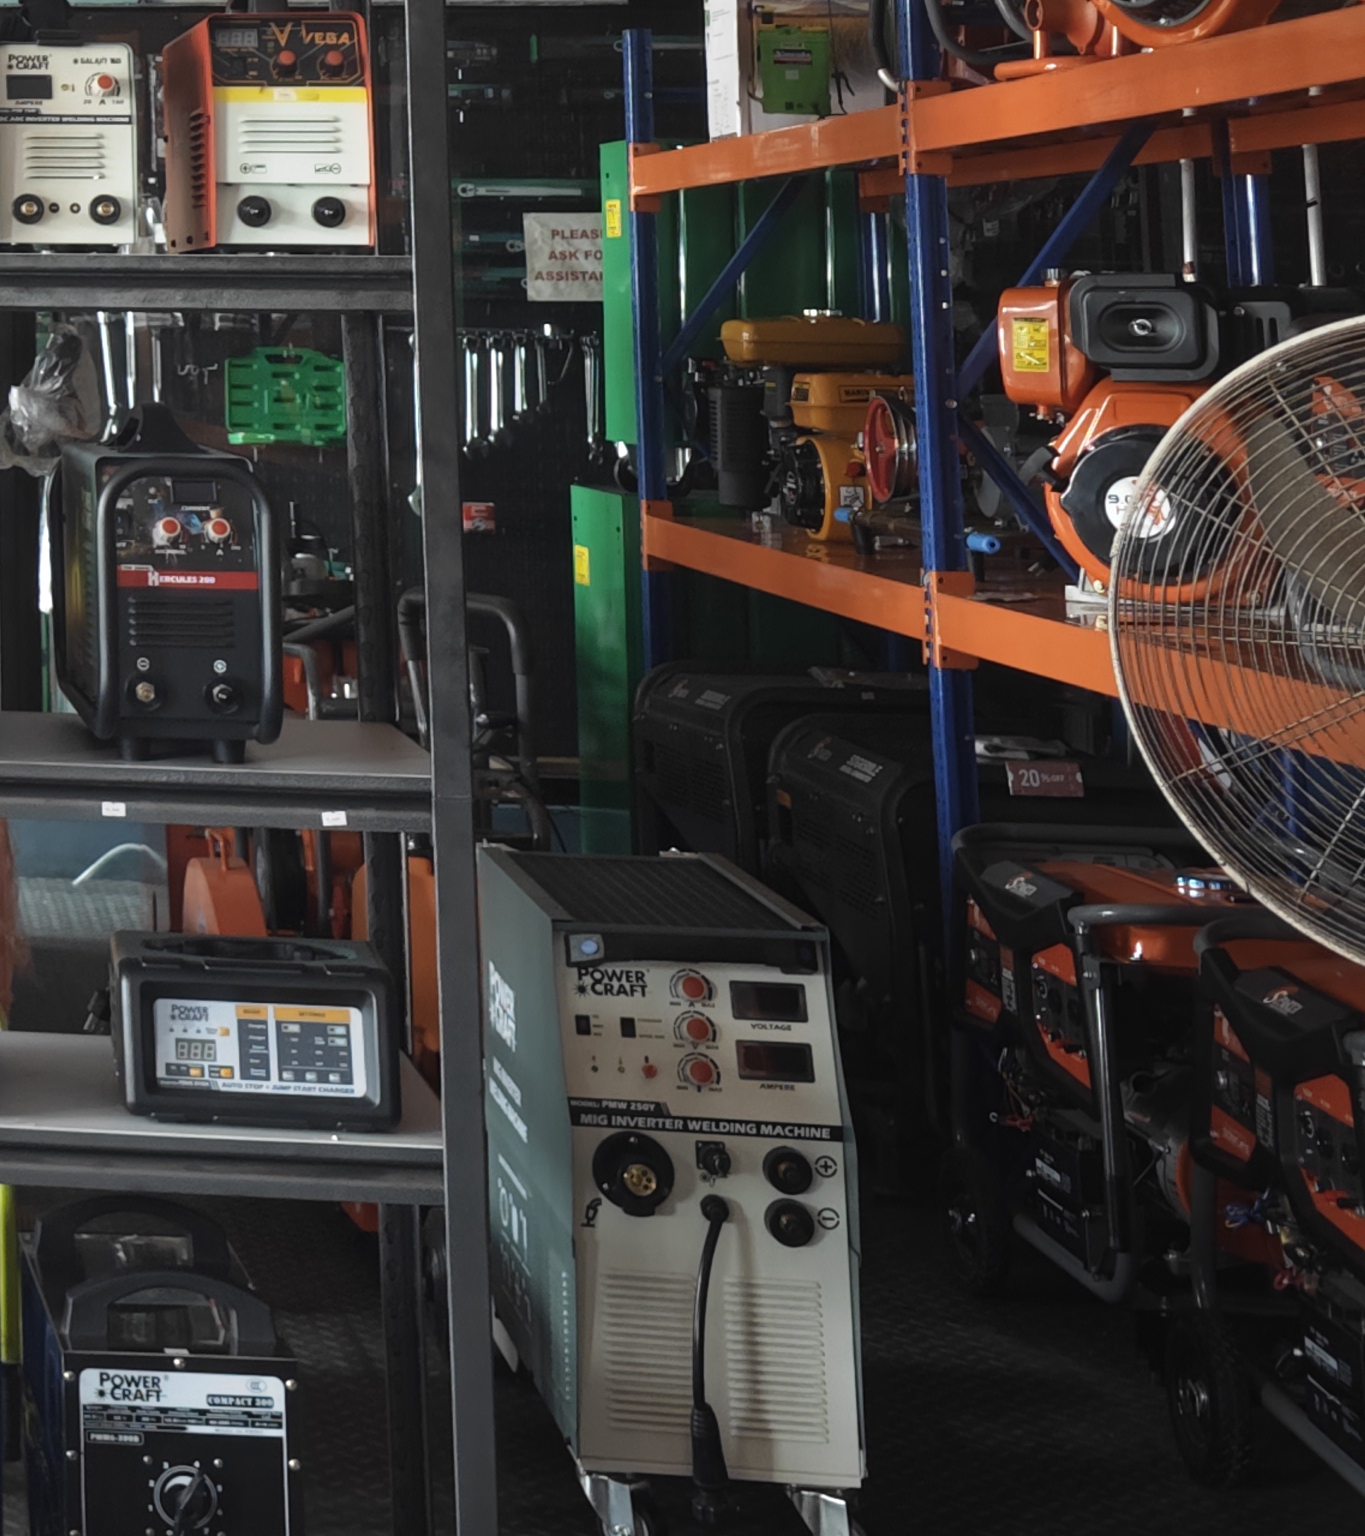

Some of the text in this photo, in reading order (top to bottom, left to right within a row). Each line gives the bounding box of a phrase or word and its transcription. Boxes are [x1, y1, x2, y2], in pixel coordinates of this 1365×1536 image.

[301, 22, 349, 44] VEGA
[9, 54, 48, 63] POWER
[16, 62, 49, 70] CRAFT
[551, 229, 602, 240] PLEAS
[548, 250, 602, 260] ASK FO
[148, 571, 197, 586] HERCULES
[577, 967, 645, 984] POWER
[590, 983, 647, 997] CRAFT
[171, 1004, 208, 1015] POWER
[178, 1013, 209, 1022] CRAFT
[751, 1023, 791, 1031] VOLTAGE
[760, 1083, 795, 1091] AMPERE
[602, 1100, 627, 1110] PMW
[630, 1102, 655, 1112] 250Y
[580, 1114, 831, 1139] MIG INVERTER WELDING MACHINE
[99, 1372, 161, 1390] POWER
[110, 1388, 162, 1402] CRAFT
[207, 1396, 251, 1406] COMPACT
